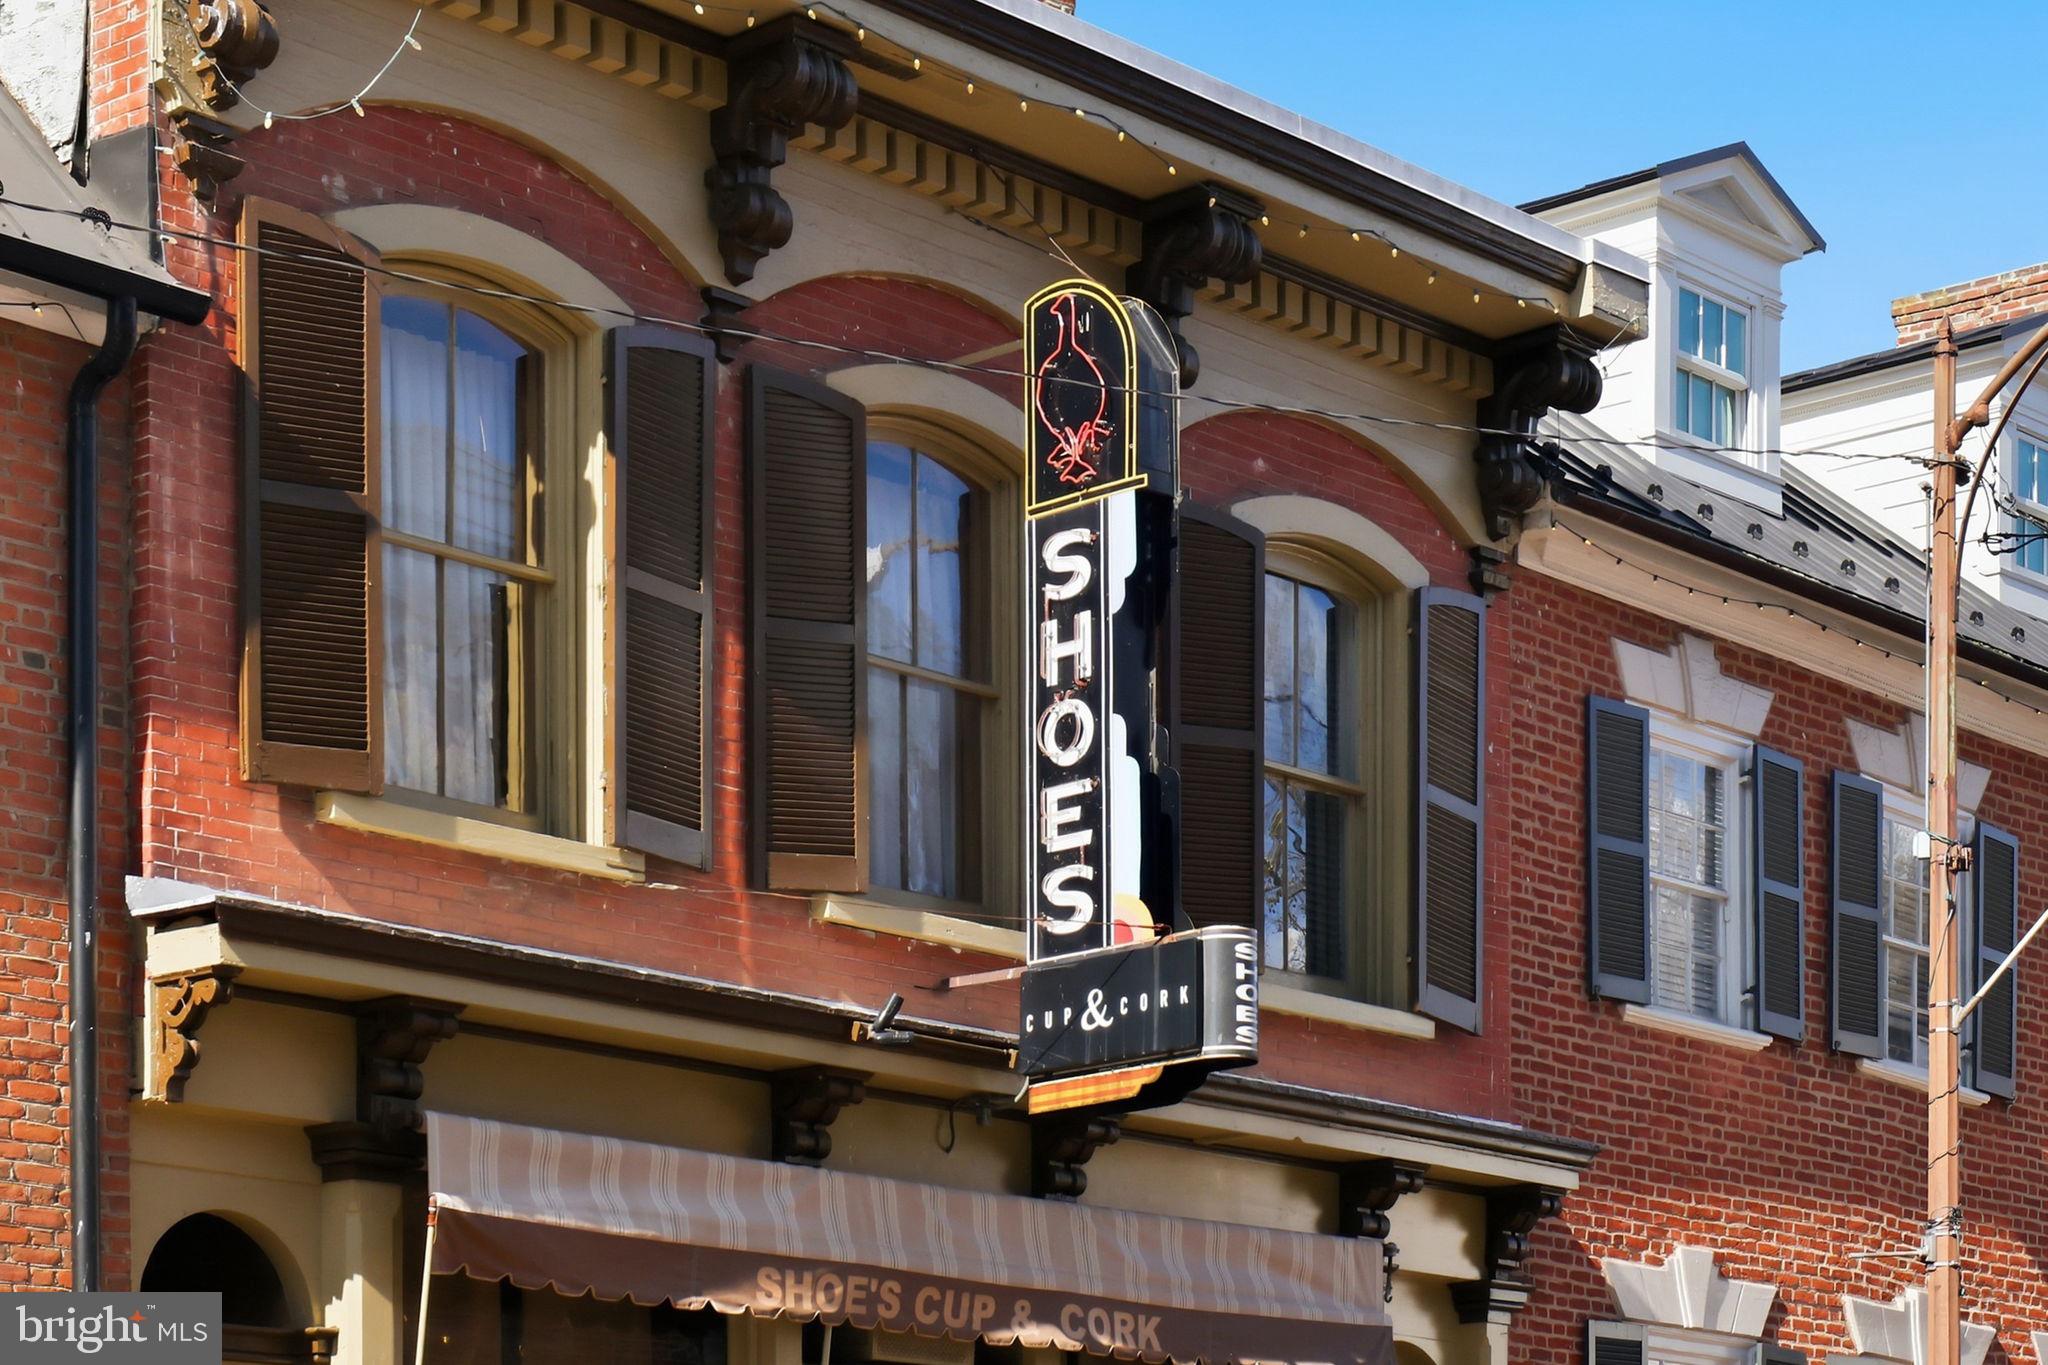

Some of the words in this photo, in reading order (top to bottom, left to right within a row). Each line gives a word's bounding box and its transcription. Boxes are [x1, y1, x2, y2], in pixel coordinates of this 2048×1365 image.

[1038, 528, 1097, 934] SHOES
[1025, 1007, 1073, 1033] CUP
[1080, 988, 1114, 1031] &
[1119, 985, 1189, 1016] CORK
[756, 1266, 902, 1319] SHOE'S
[915, 1286, 996, 1331] CUP
[1011, 1299, 1040, 1336] &
[1060, 1303, 1162, 1352] CORK
